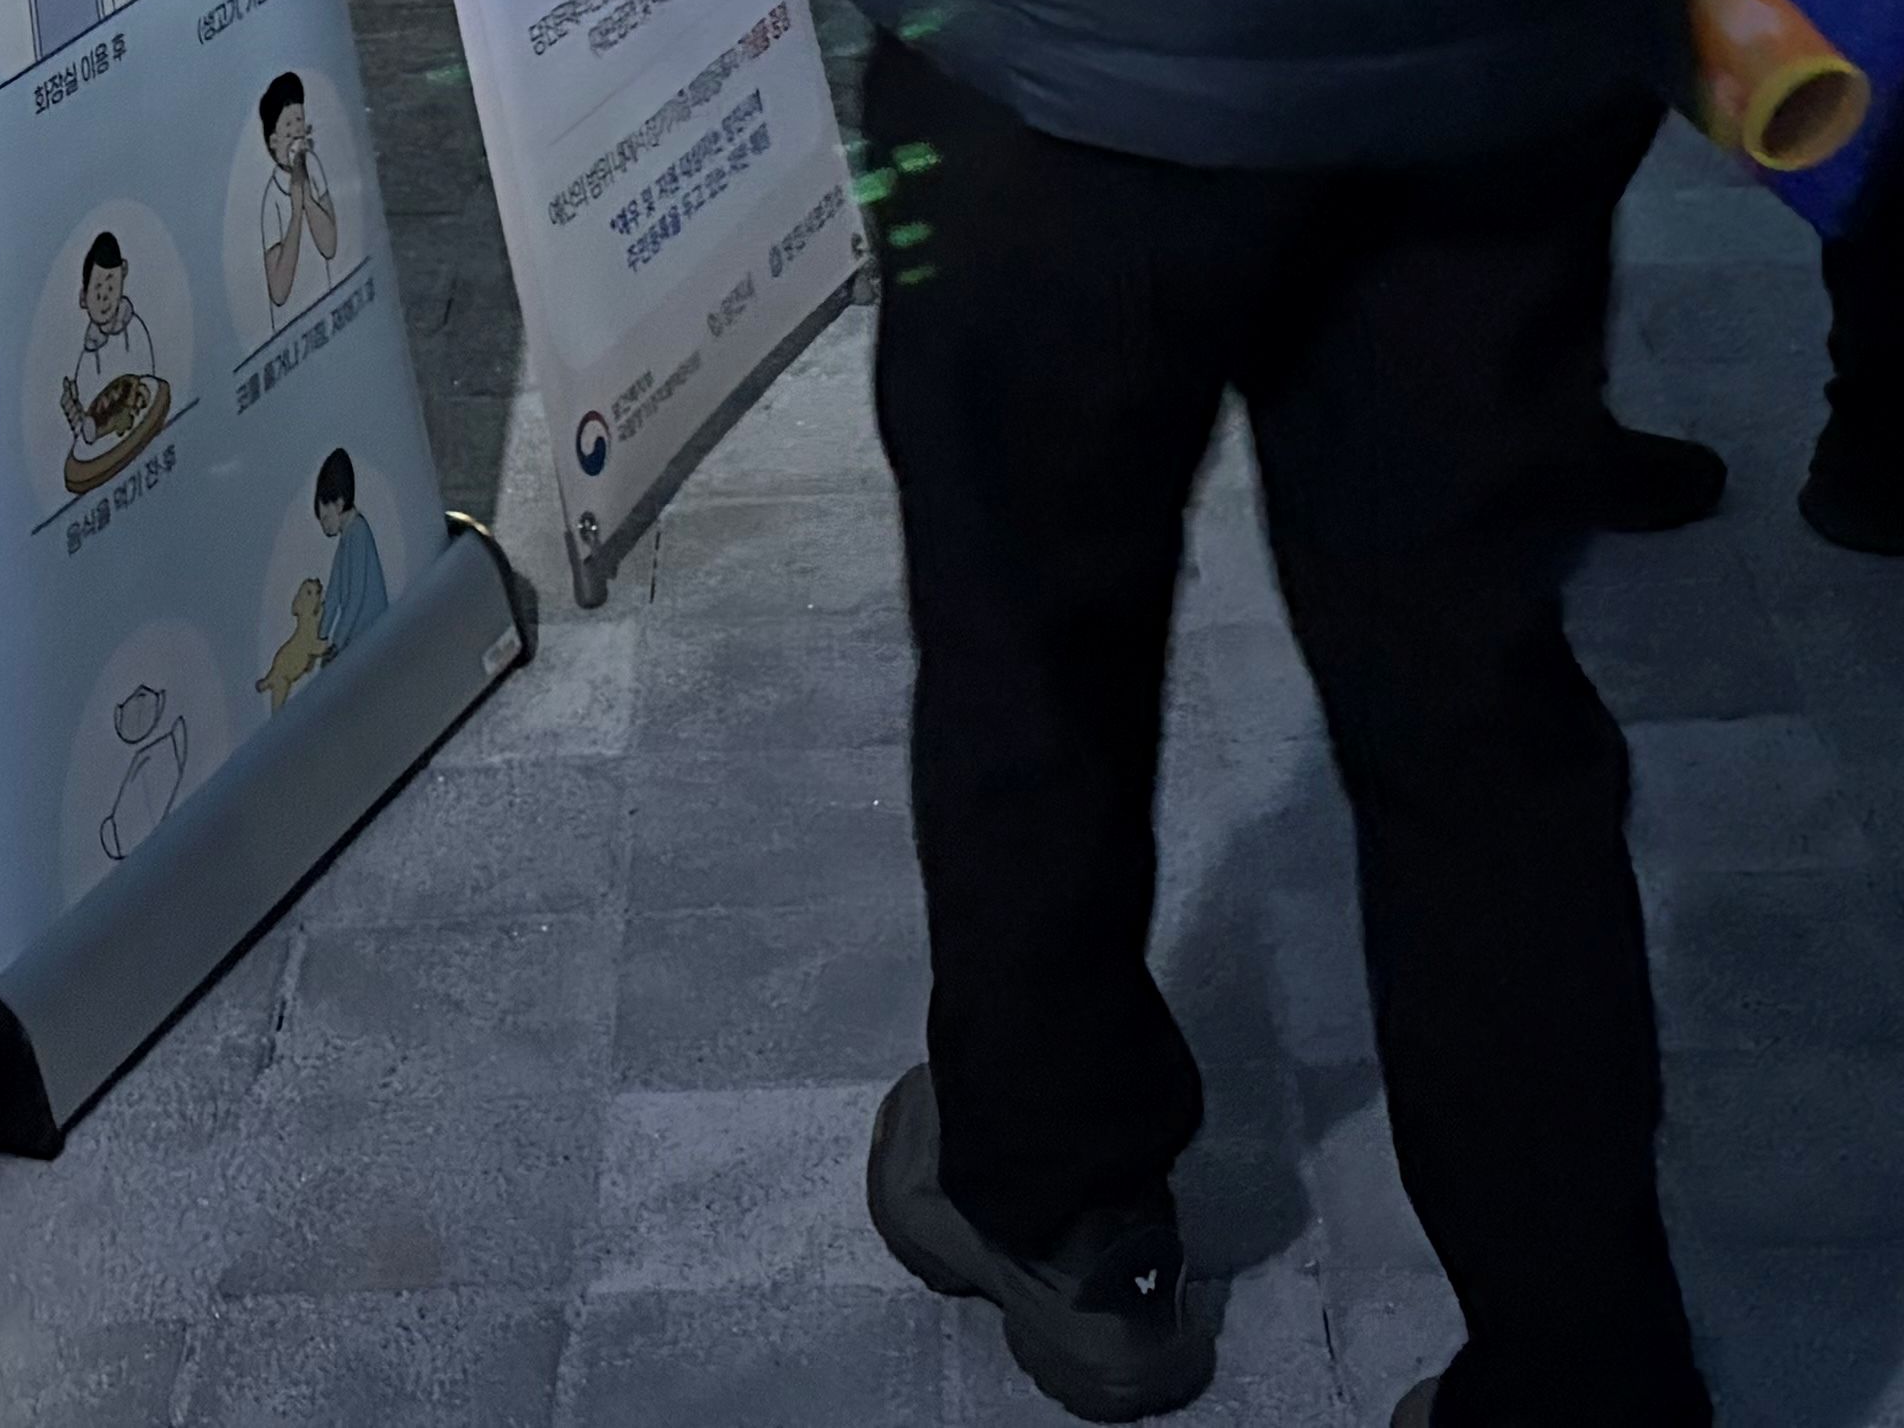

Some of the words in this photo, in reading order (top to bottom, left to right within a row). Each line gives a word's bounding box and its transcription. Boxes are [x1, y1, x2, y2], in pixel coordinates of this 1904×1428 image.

[34, 61, 79, 115] 화장실
[80, 41, 110, 82] 이용
[111, 32, 127, 62] 후
